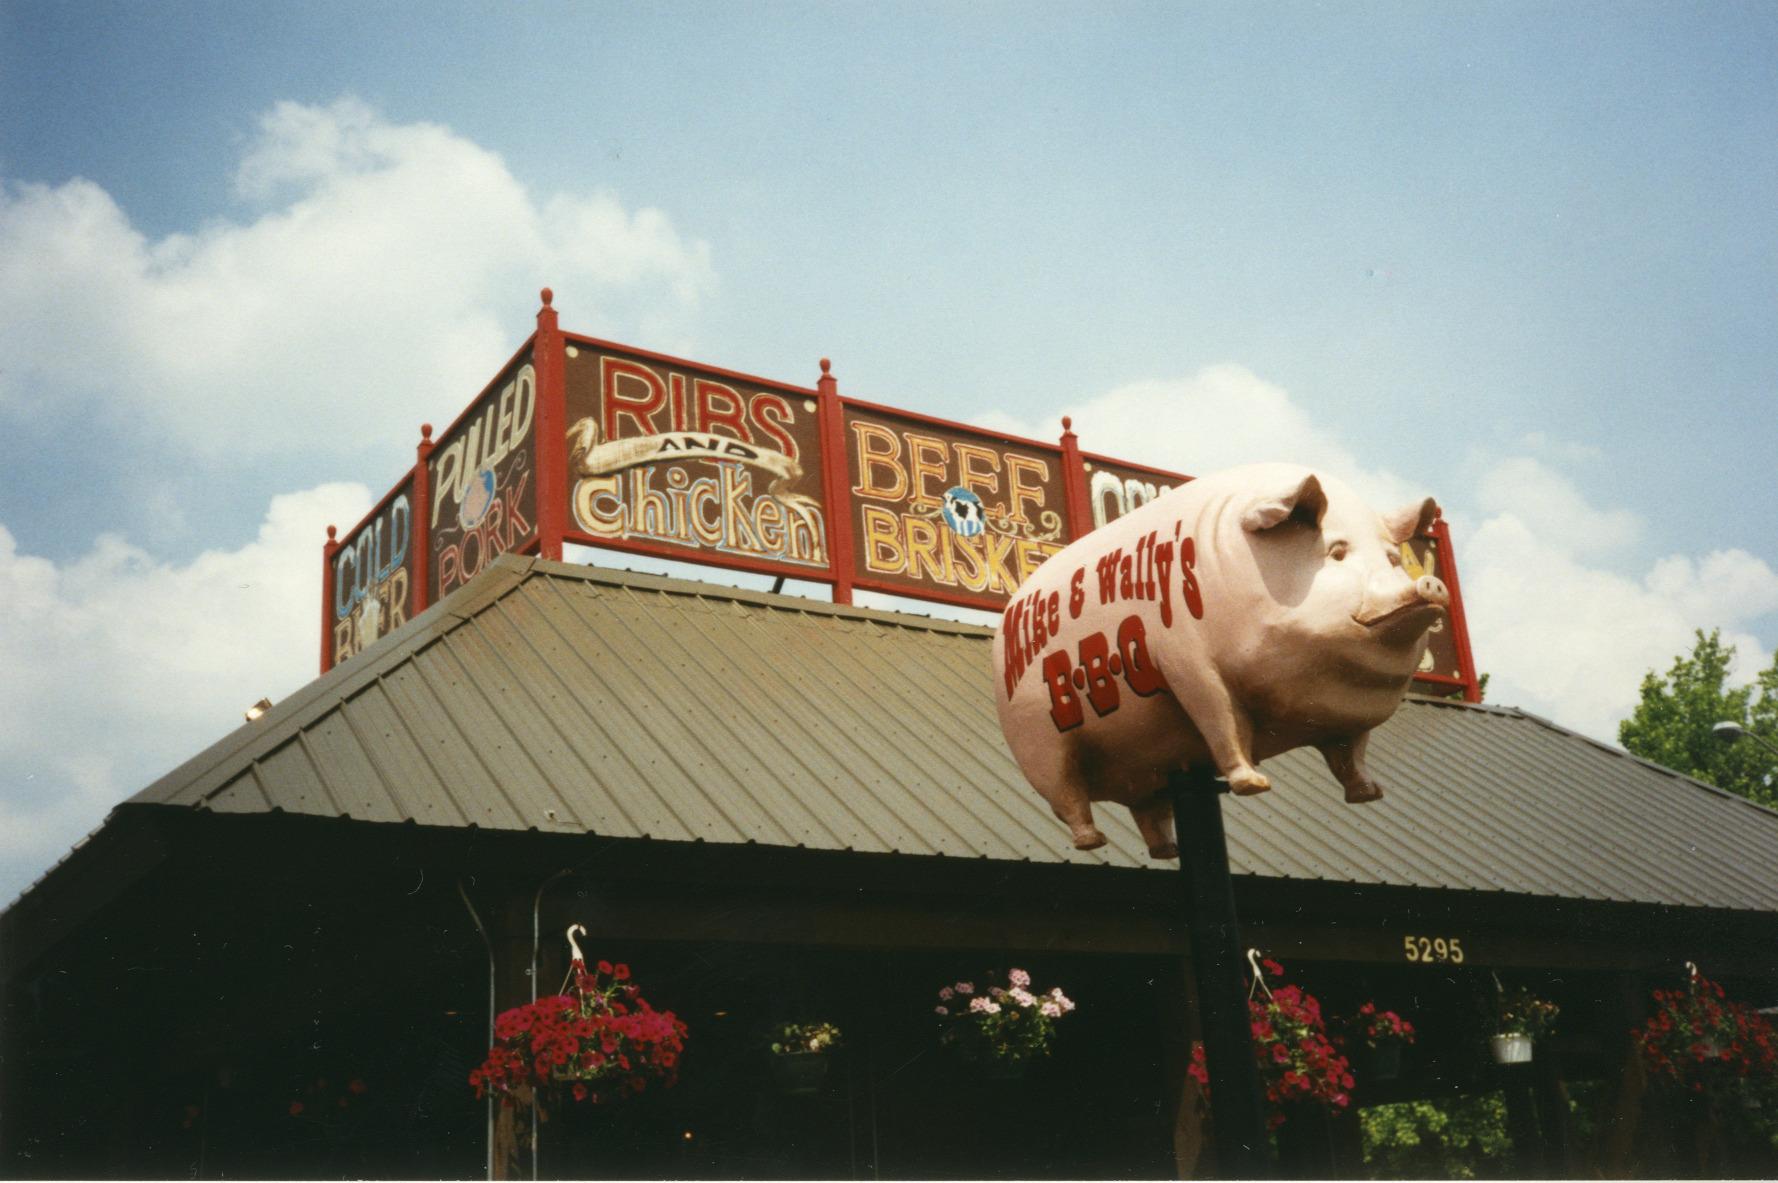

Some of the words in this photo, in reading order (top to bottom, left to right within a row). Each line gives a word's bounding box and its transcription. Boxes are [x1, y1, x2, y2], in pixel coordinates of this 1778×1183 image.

[432, 363, 537, 529] PULLED
[600, 355, 800, 464] RIBS
[659, 438, 759, 460] AND
[851, 421, 1050, 526] BEEF
[336, 494, 411, 622] COLD
[440, 470, 531, 600] PORK
[1003, 589, 1060, 702] Mike
[1069, 567, 1086, 620] &
[1096, 519, 1204, 629] Wally's
[1404, 936, 1464, 963] 5295
